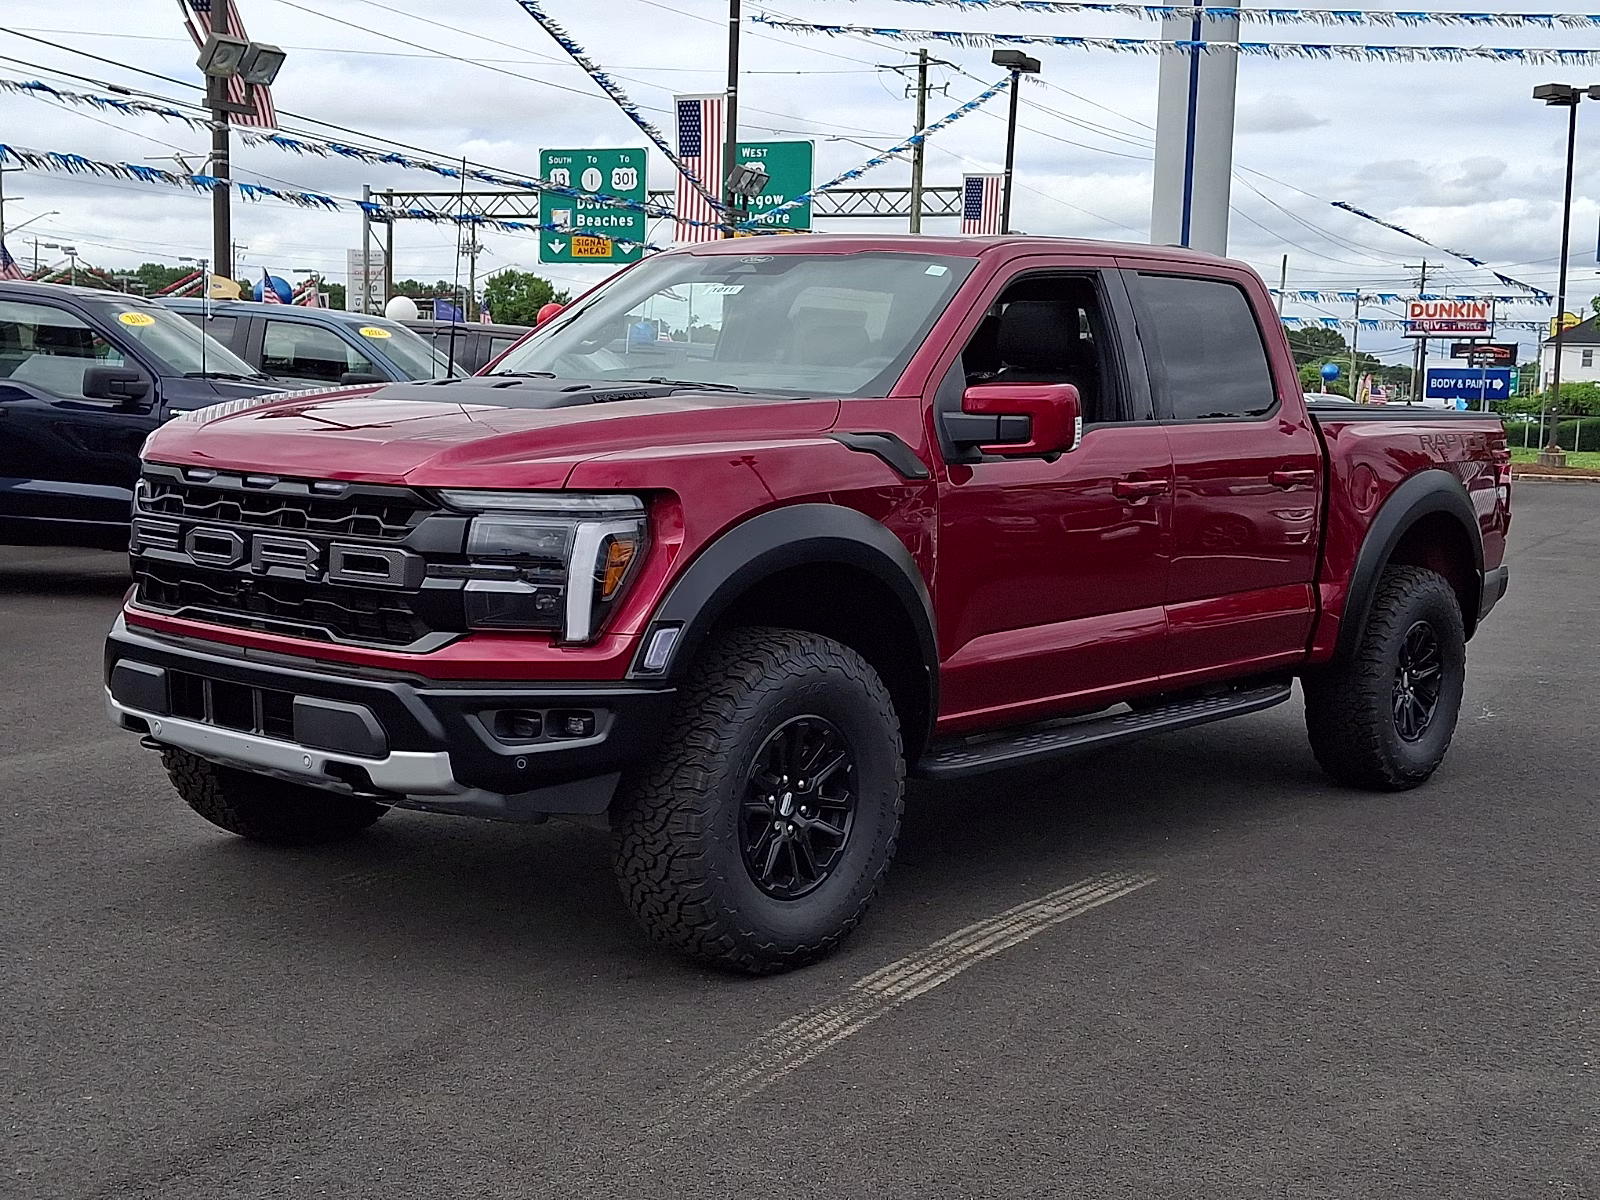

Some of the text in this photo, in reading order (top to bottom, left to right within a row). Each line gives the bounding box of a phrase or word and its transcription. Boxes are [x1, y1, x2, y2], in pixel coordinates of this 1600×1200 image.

[742, 147, 768, 157] WEST
[548, 155, 572, 164] SOUTH
[554, 172, 634, 186] 13 1 301
[576, 198, 614, 210] Dove
[734, 193, 784, 209] lsgow
[576, 214, 634, 227] Beaches
[1410, 303, 1491, 318] DUNKIN'
[1430, 378, 1456, 389] BODY
[1457, 379, 1464, 389] &
[1420, 433, 1490, 451] RAPTOR
[131, 518, 426, 594] FORD
